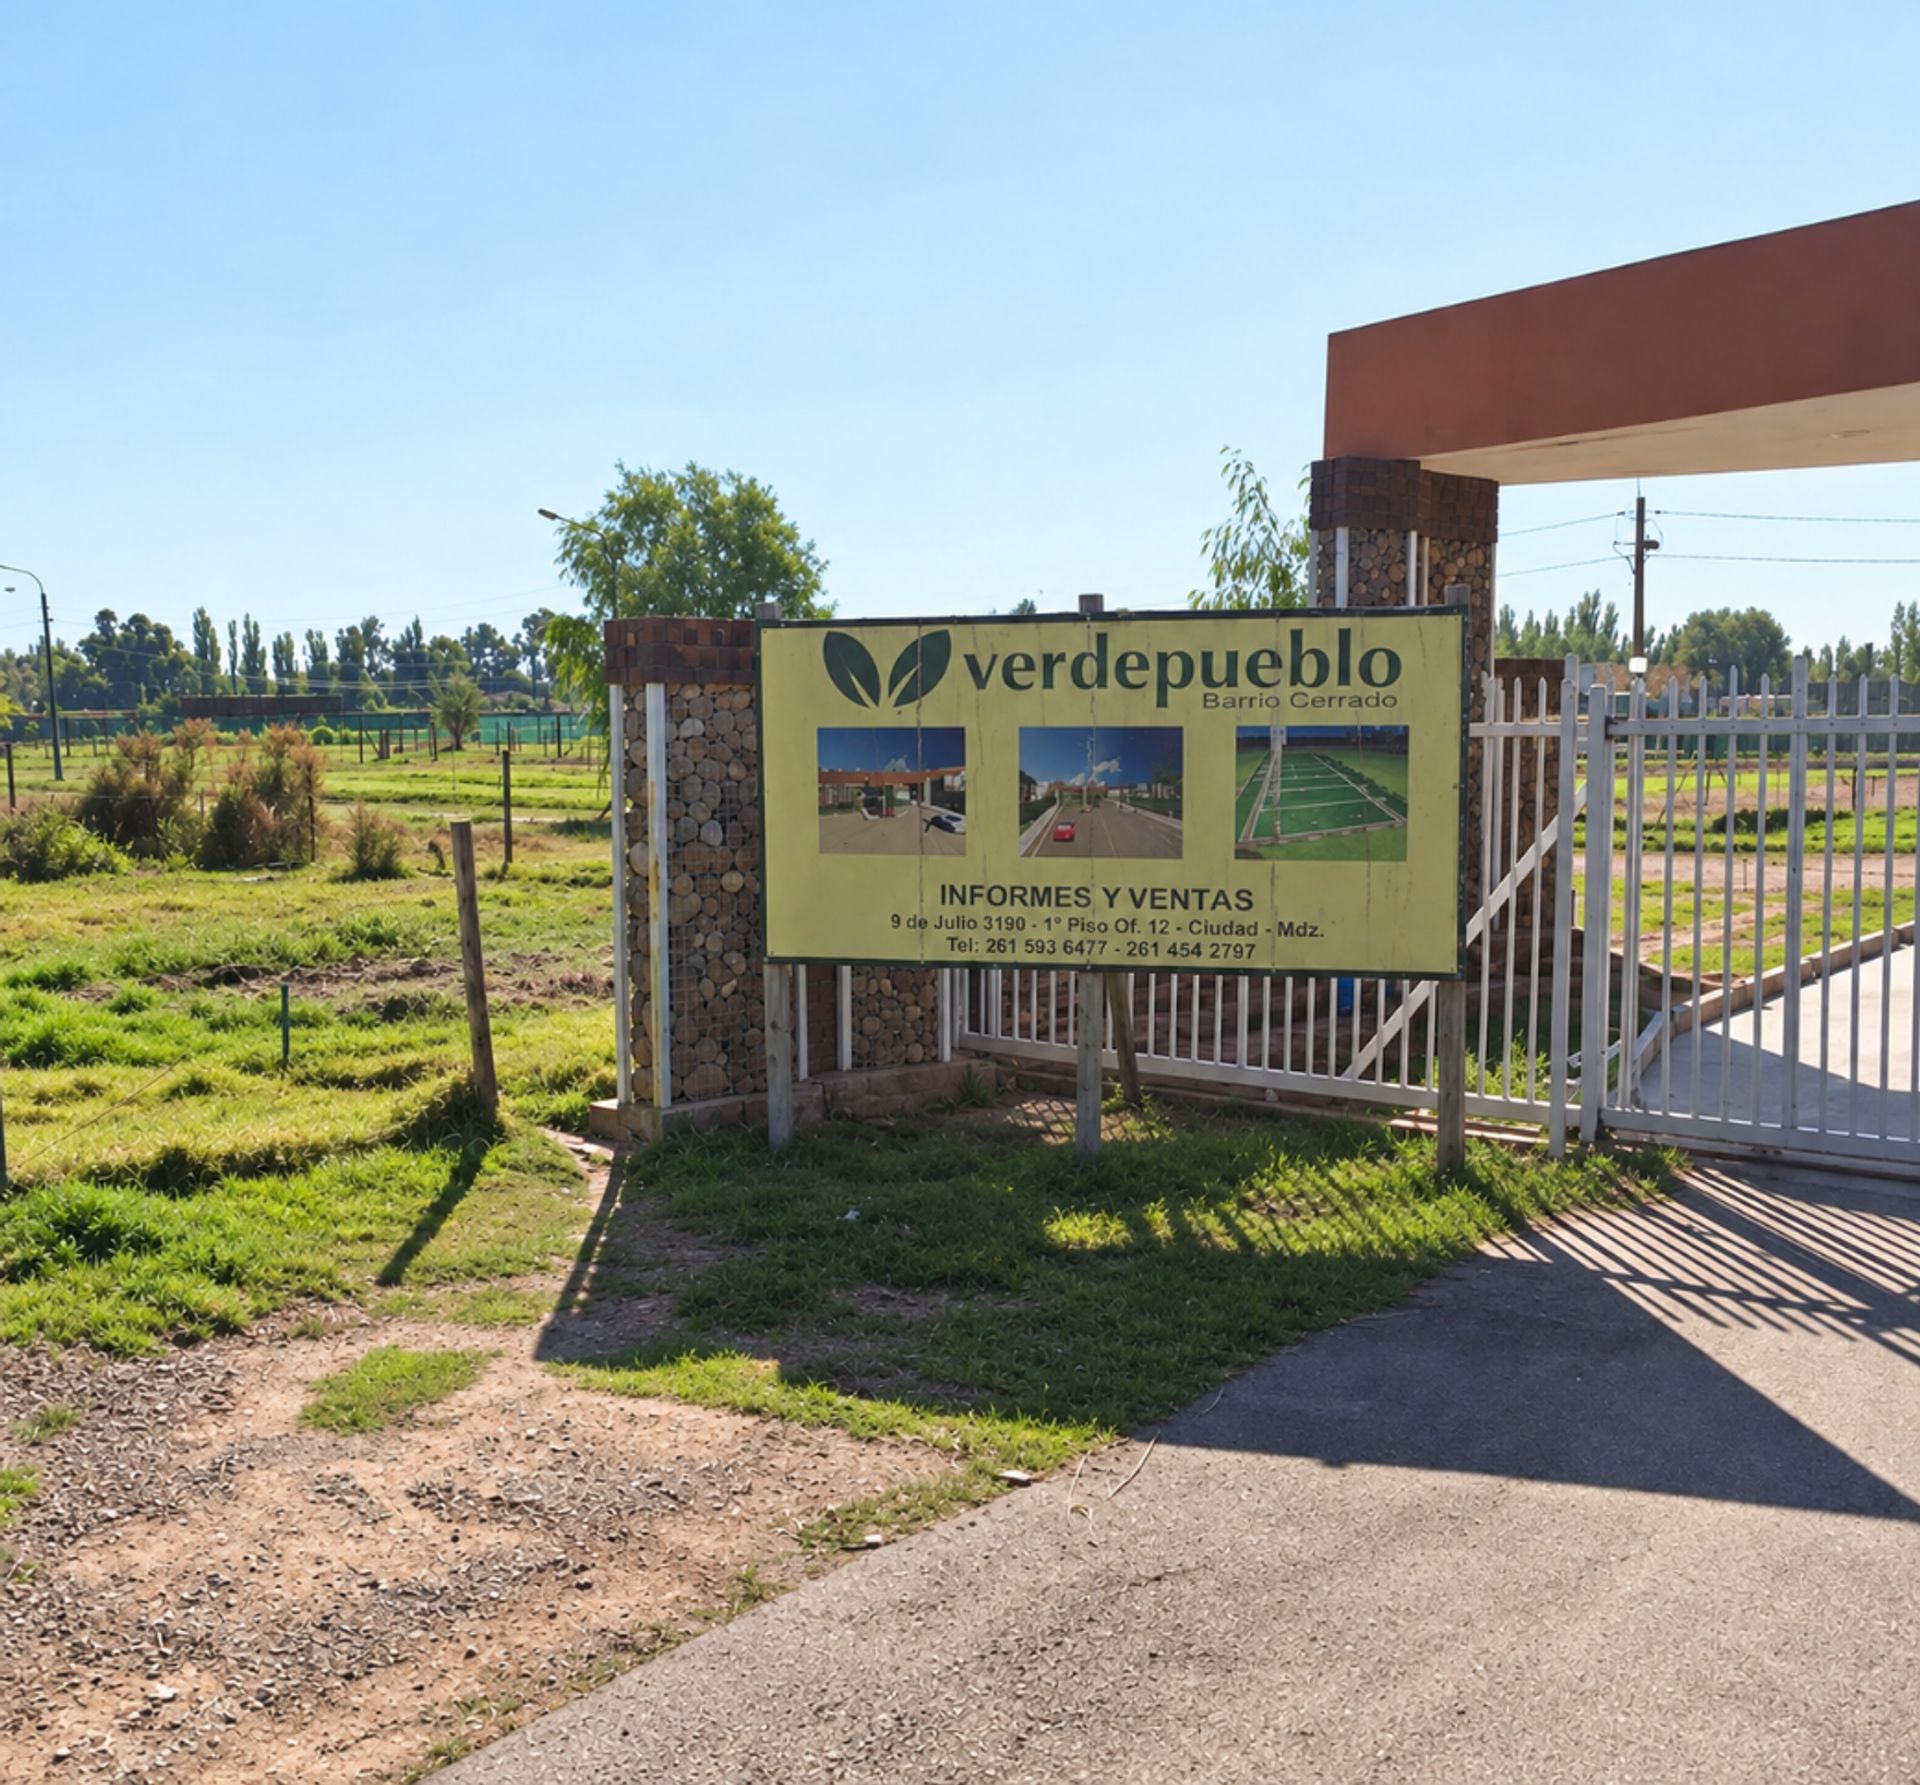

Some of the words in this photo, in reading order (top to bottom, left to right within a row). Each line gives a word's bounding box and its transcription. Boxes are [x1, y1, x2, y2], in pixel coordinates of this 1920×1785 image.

[963, 627, 1402, 709] verdepueblo
[1203, 692, 1280, 709] Barrio
[1290, 692, 1398, 709] Cerrado
[940, 884, 1090, 908] INFORMES
[1101, 887, 1121, 909] Y
[1129, 888, 1254, 911] VENTAS
[890, 914, 901, 928] 9
[906, 914, 927, 929] de
[934, 914, 977, 930] Julio
[983, 914, 1025, 931] 3190
[1068, 917, 1108, 933] Piso
[1115, 918, 1141, 934] Of.
[1149, 918, 1169, 933] 12
[1188, 919, 1258, 936] Ciudad
[1278, 920, 1324, 937] Mdz.
[946, 936, 979, 953] Tel:
[986, 938, 1016, 954] 261
[1024, 939, 1056, 955] 593
[1063, 940, 1107, 956] 6477
[1126, 941, 1160, 957] 261
[1167, 942, 1202, 958] 454
[1209, 943, 1256, 960] 2797
